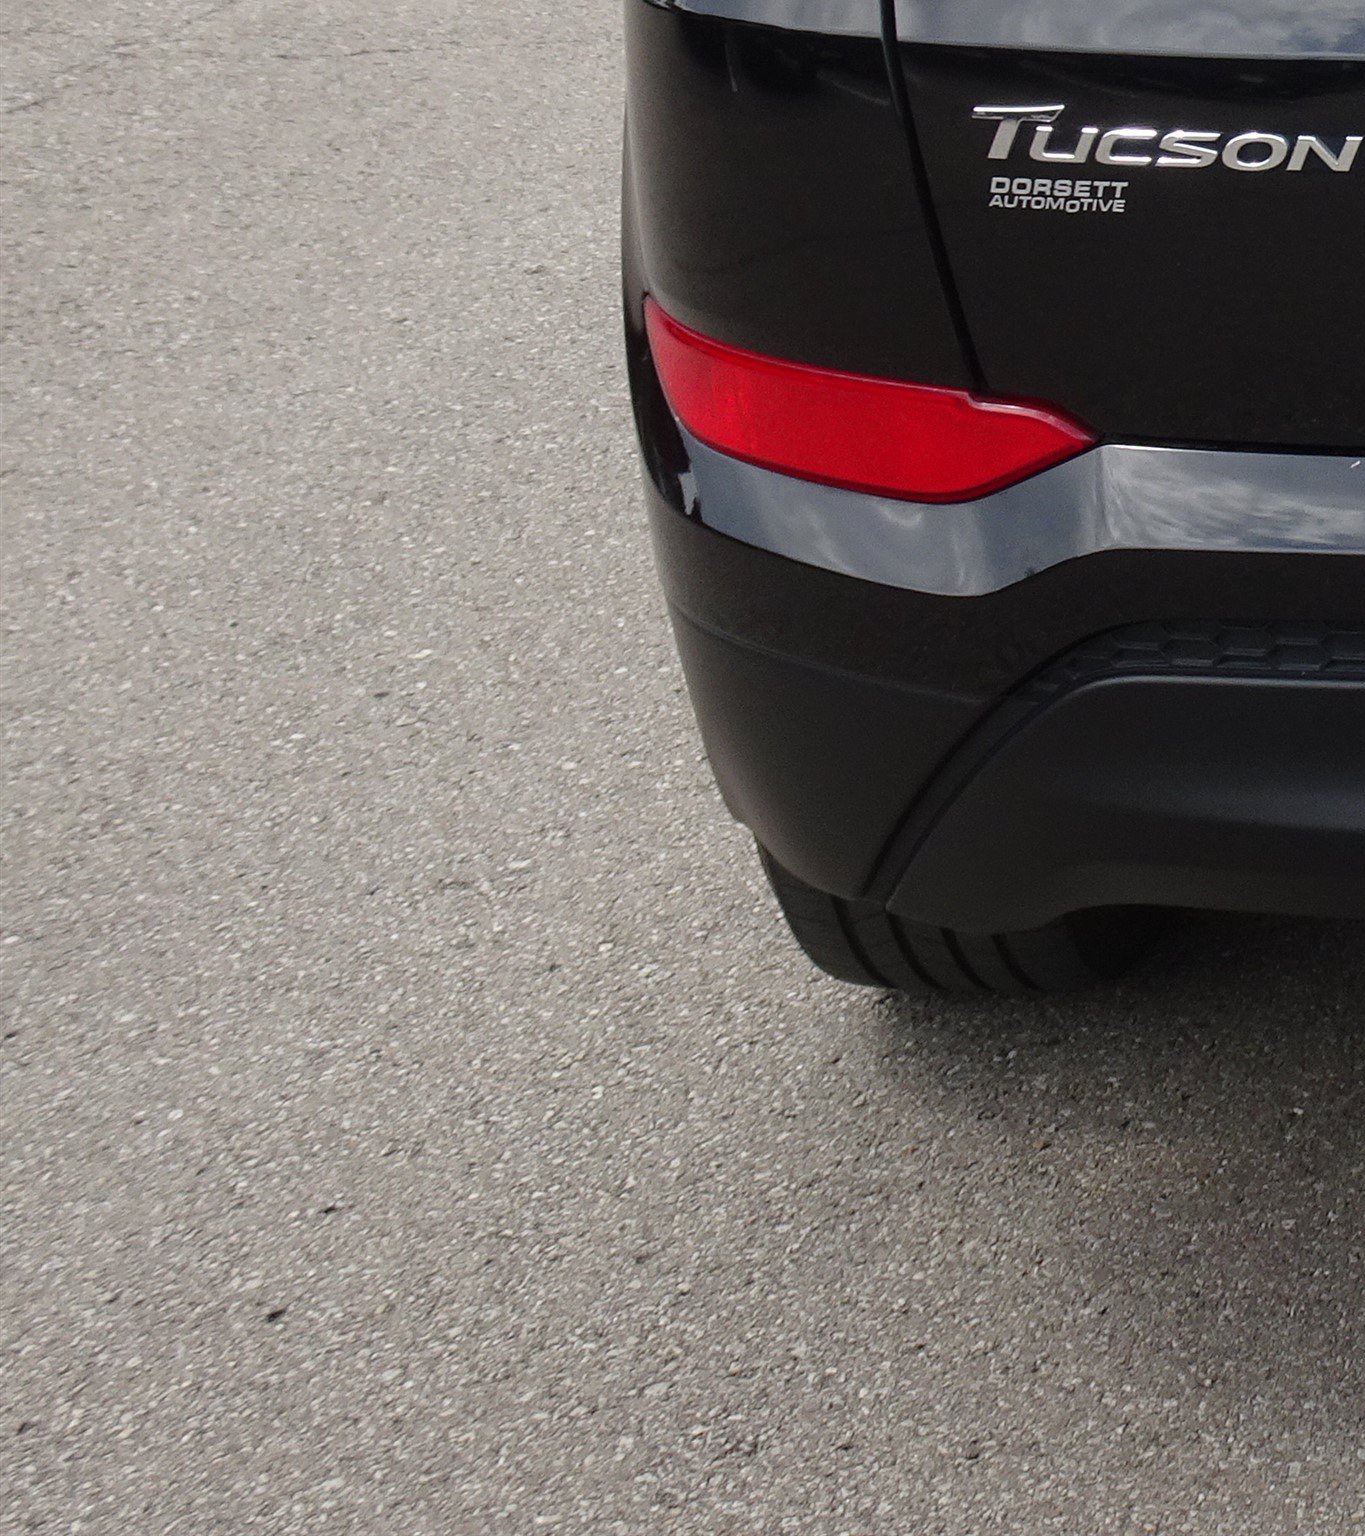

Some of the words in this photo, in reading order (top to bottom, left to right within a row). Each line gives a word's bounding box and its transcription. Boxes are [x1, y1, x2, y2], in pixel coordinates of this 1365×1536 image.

[972, 104, 1364, 172] TUCSON
[989, 176, 1129, 199] DORSETT
[988, 194, 1127, 214] AUTOMOTIVE
